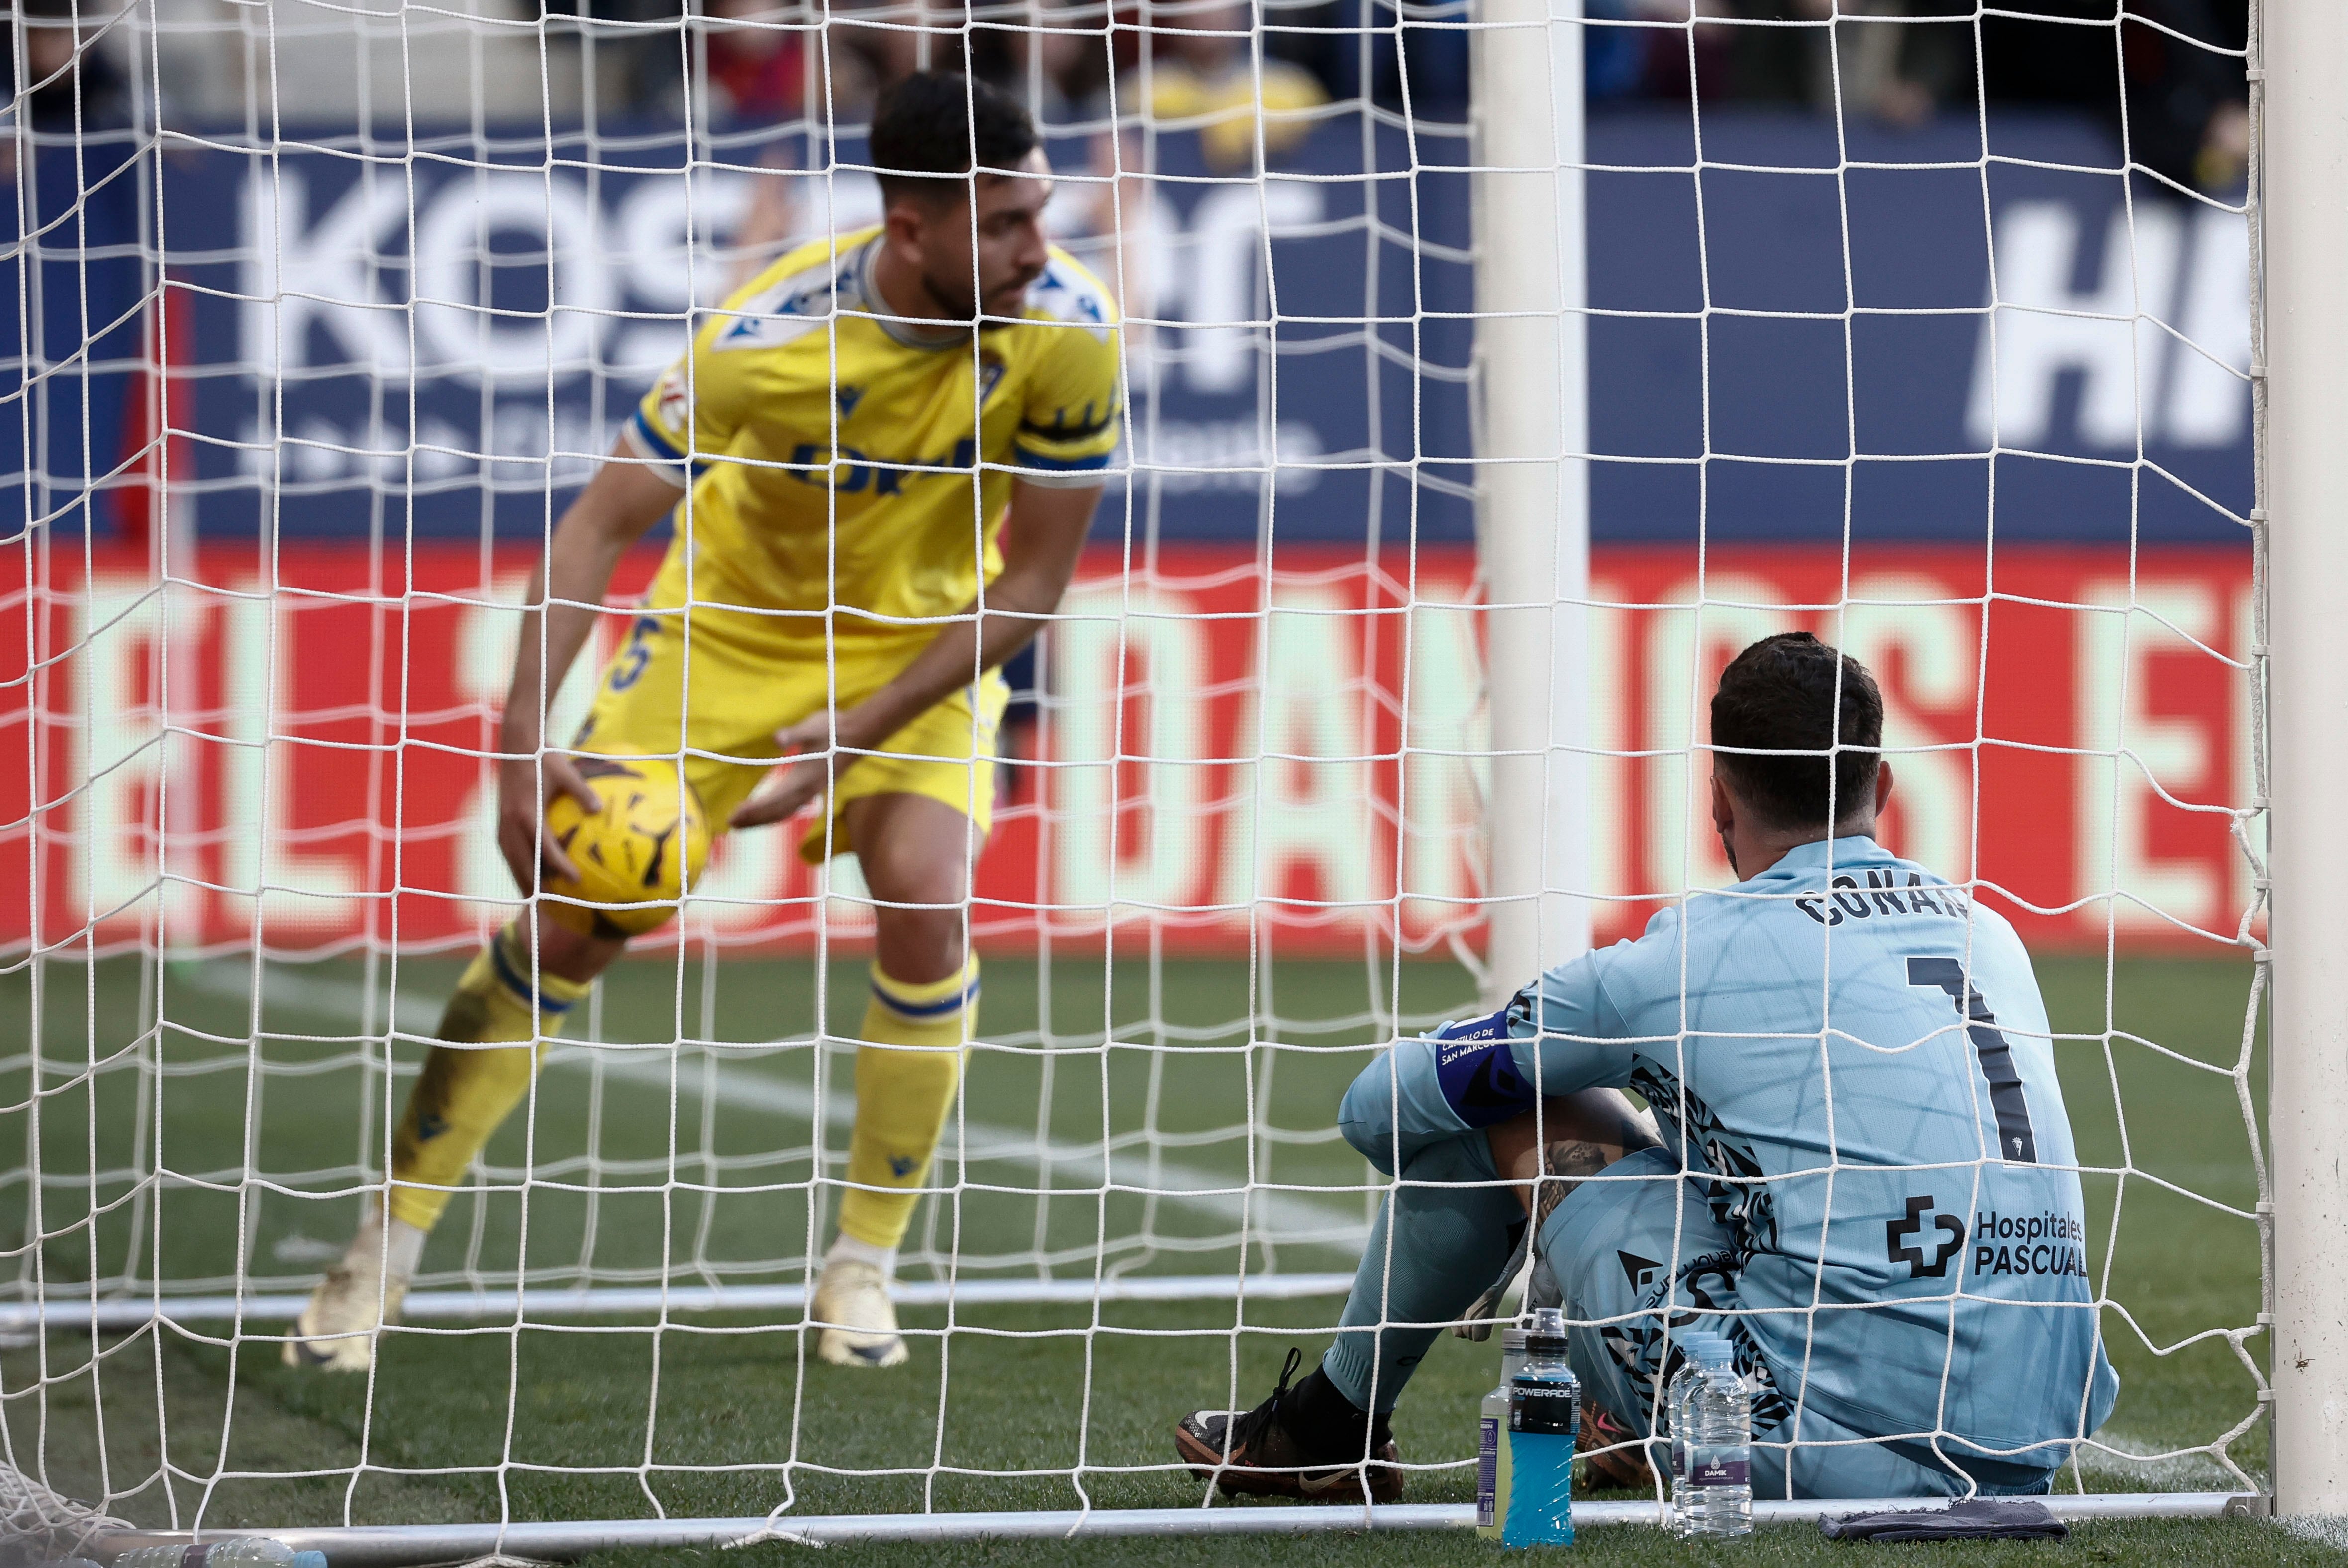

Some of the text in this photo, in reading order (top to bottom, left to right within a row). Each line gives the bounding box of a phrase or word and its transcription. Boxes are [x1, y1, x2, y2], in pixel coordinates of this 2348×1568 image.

[70, 572, 361, 928] EL
[1482, 1028, 1494, 1037] DE
[1442, 1051, 1458, 1066] SAN
[1977, 1210, 2082, 1245] Hospitales
[1975, 1244, 2087, 1277] PASCUAL
[1513, 1387, 1572, 1398] POWERADE
